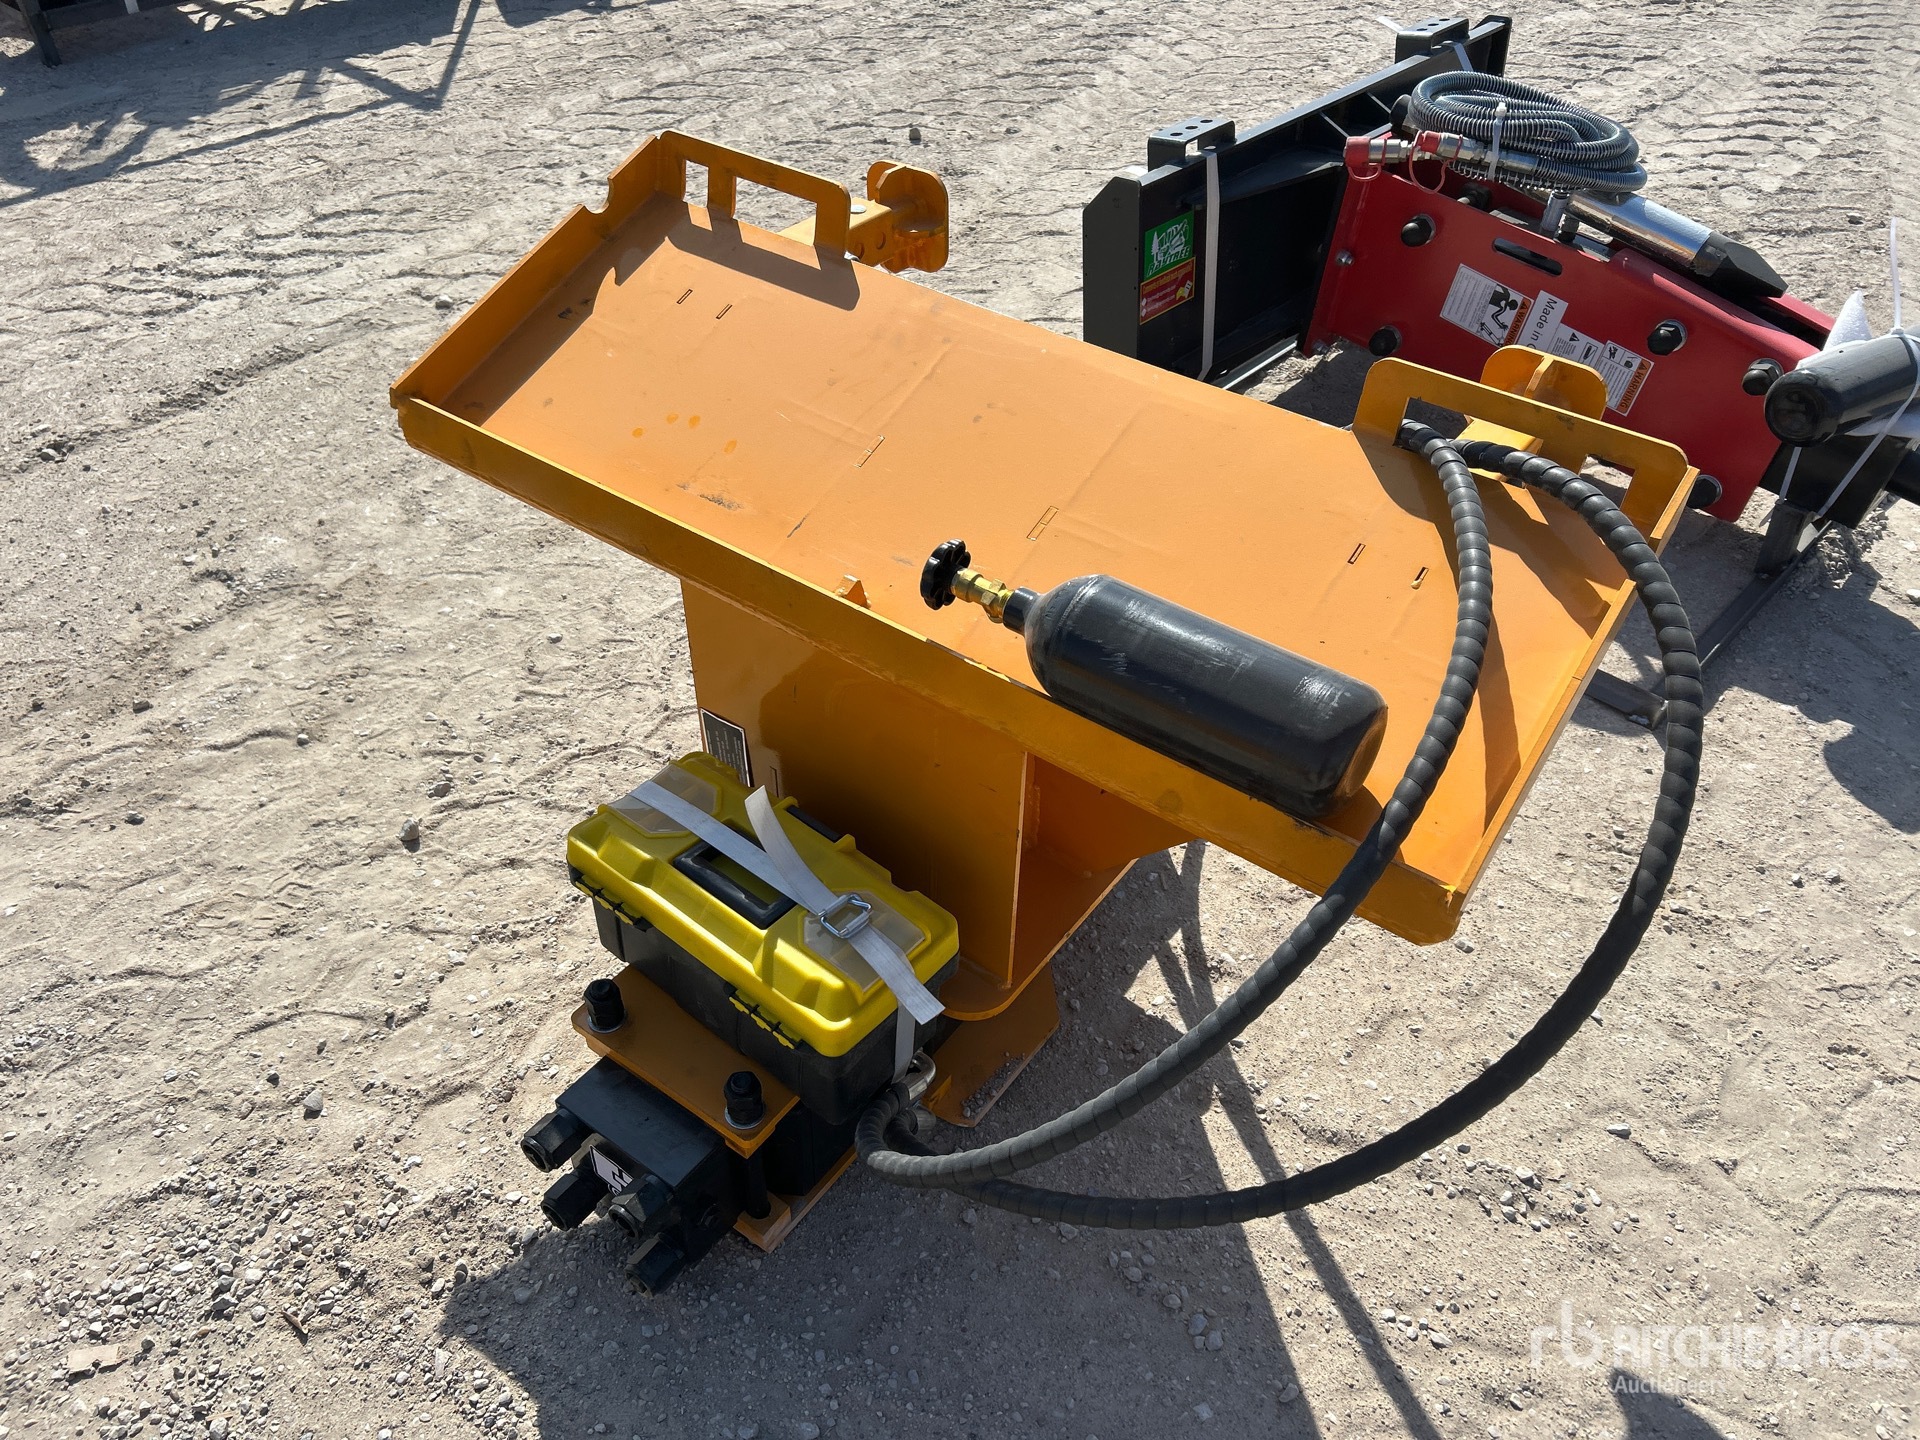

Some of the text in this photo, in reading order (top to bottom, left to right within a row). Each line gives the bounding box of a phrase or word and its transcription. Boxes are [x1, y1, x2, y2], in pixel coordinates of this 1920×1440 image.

[1536, 298, 1557, 330] Made
[1530, 331, 1542, 343] in
[1619, 371, 1643, 409] WARNING
